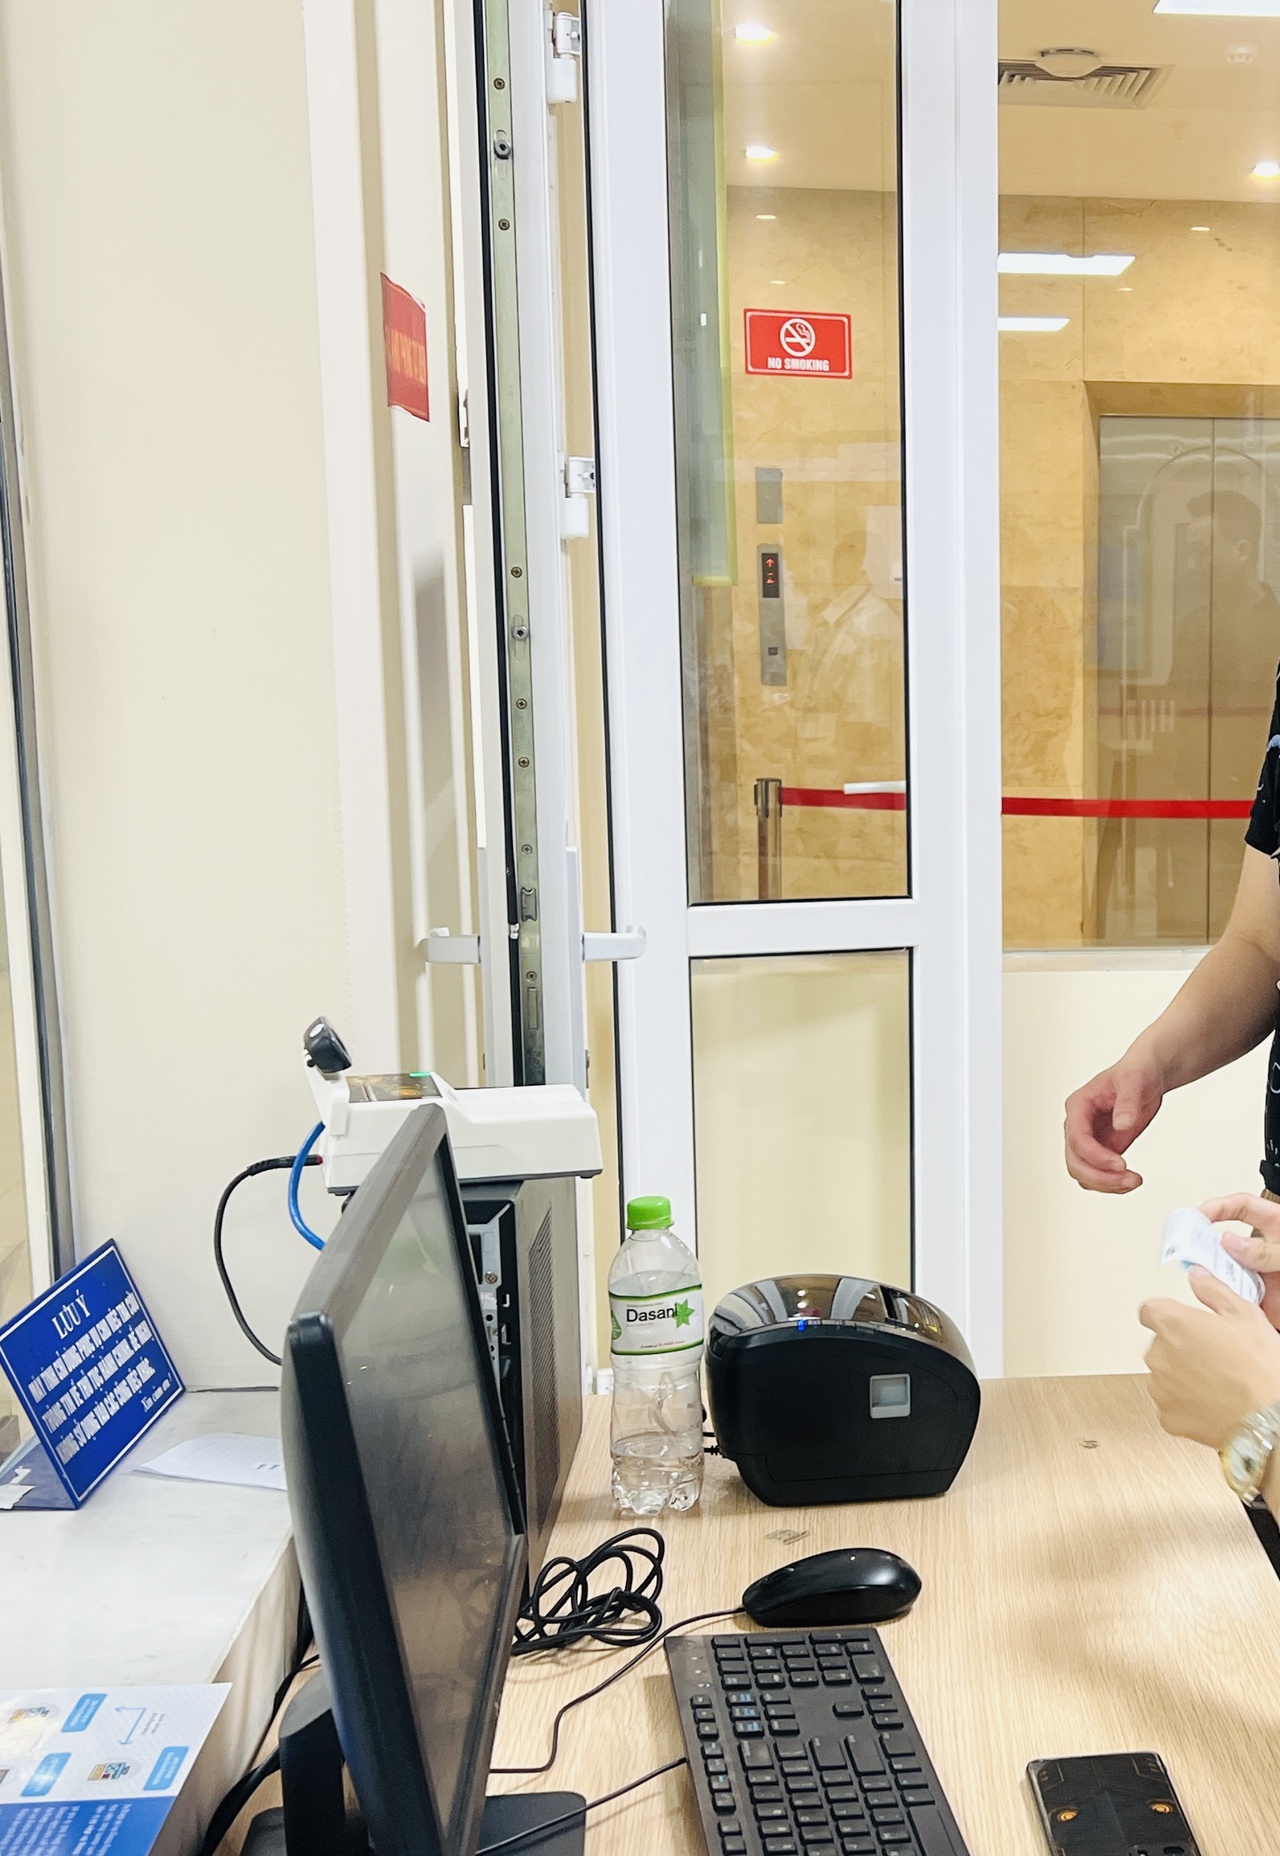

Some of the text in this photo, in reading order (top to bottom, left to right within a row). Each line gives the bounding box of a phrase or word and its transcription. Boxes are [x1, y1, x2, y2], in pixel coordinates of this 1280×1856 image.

[767, 357, 830, 372] NO SMOKING
[51, 1302, 81, 1340] LƯU
[626, 1302, 678, 1322] Dasani
